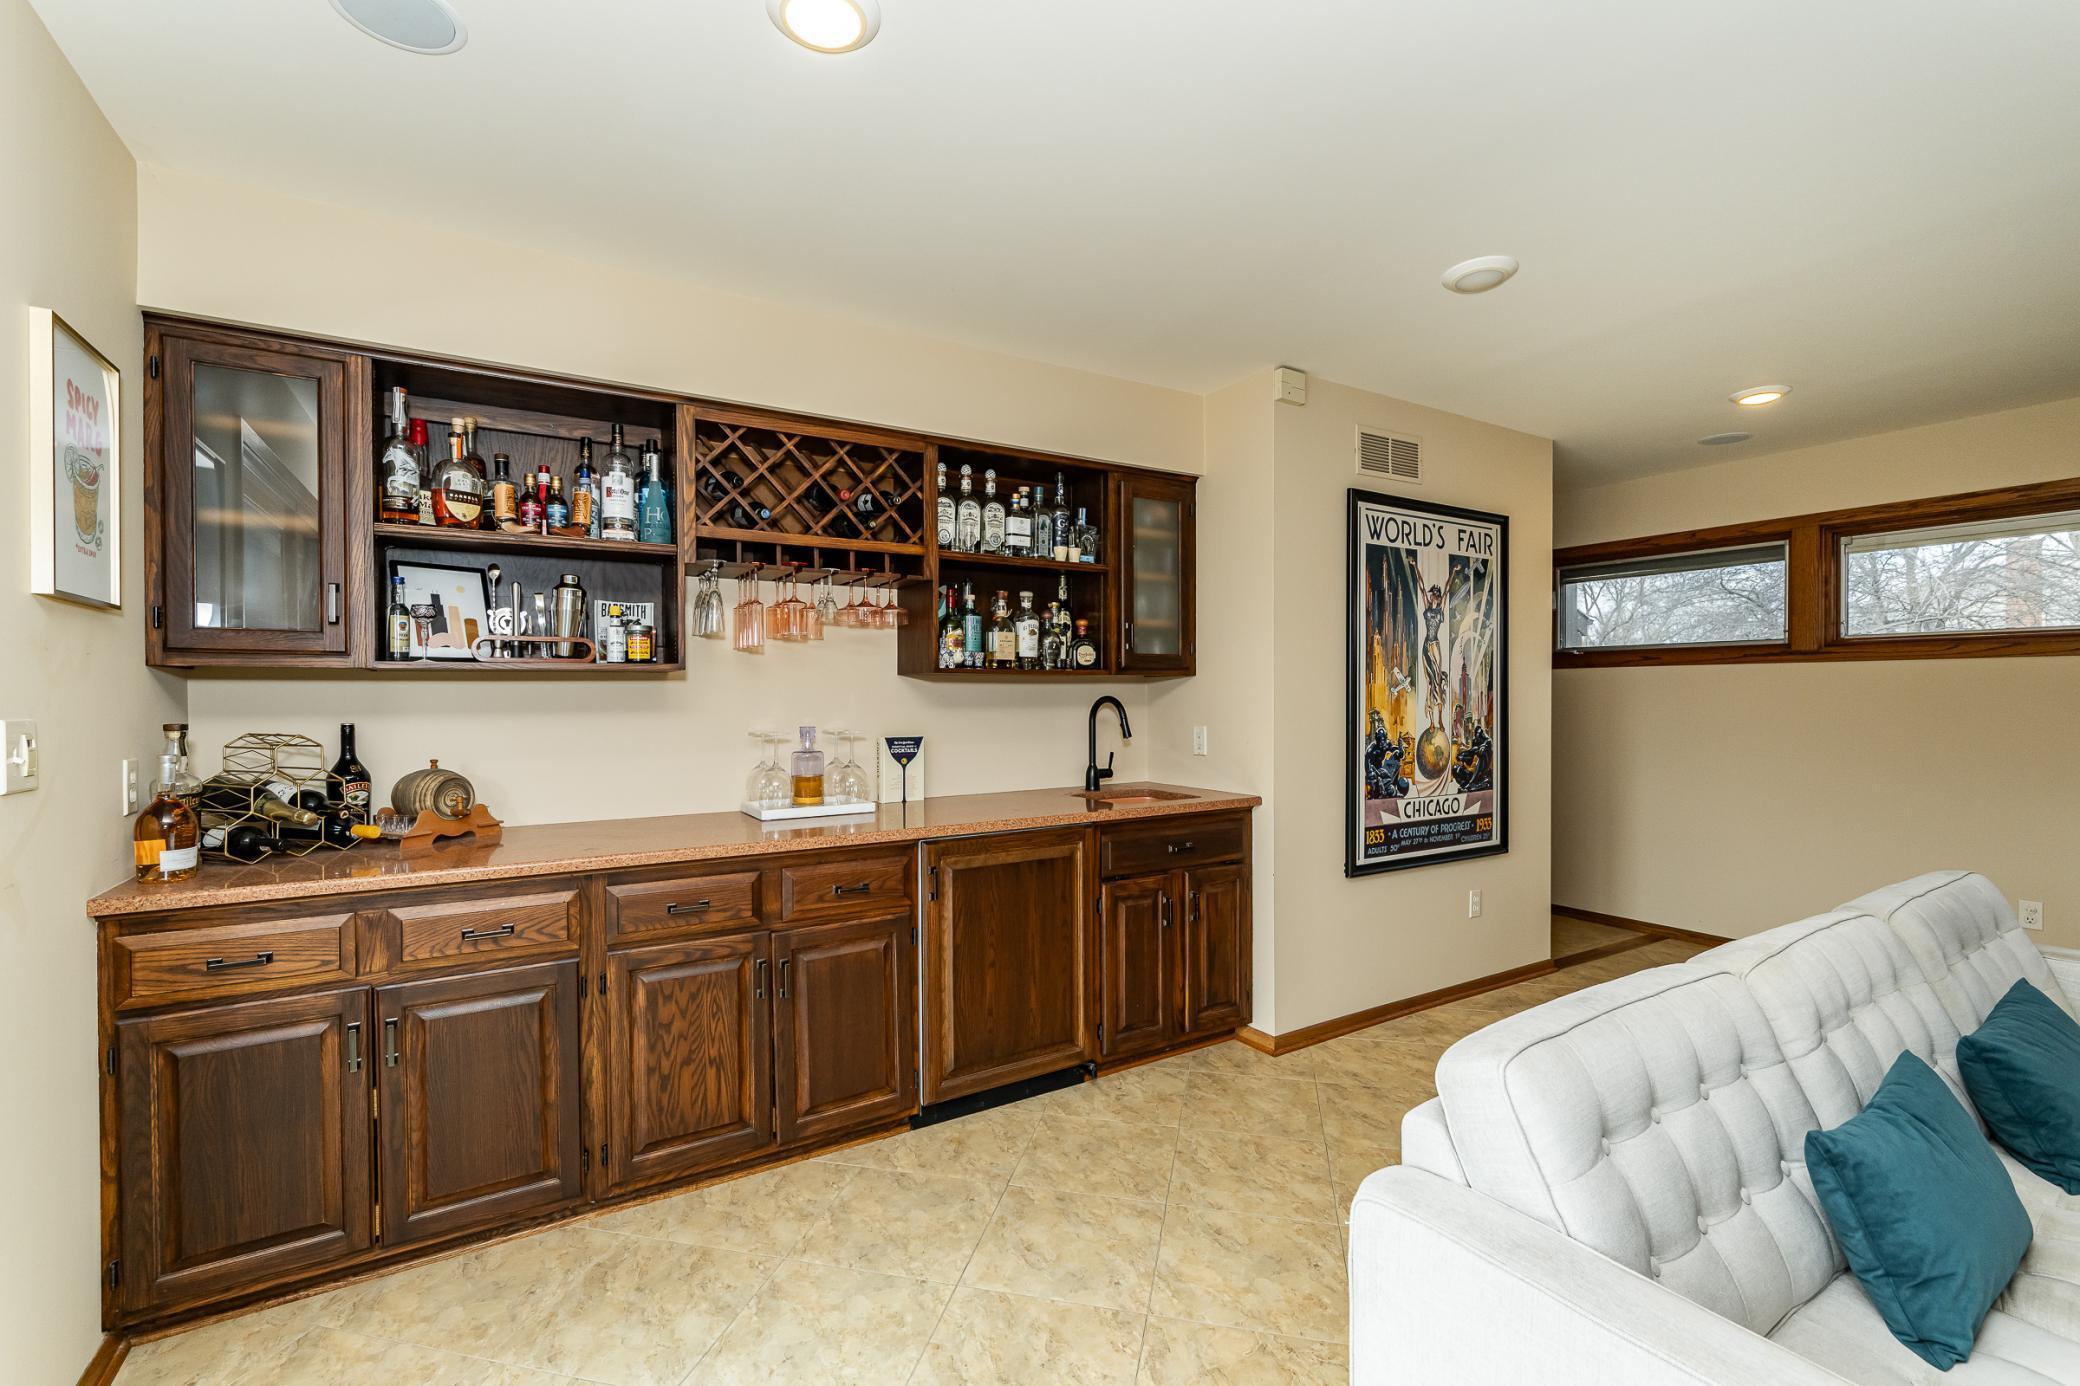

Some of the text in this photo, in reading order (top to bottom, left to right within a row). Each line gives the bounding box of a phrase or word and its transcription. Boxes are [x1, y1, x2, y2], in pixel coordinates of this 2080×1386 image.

[67, 378, 99, 427] SPICY
[1365, 513, 1493, 557] WORLD'S FAIR
[1403, 797, 1461, 819] CHICAGO
[1366, 816, 1492, 845] 1833 A CENTURY OF PROGRESS 1933
[1367, 845, 1387, 855] ADULTS
